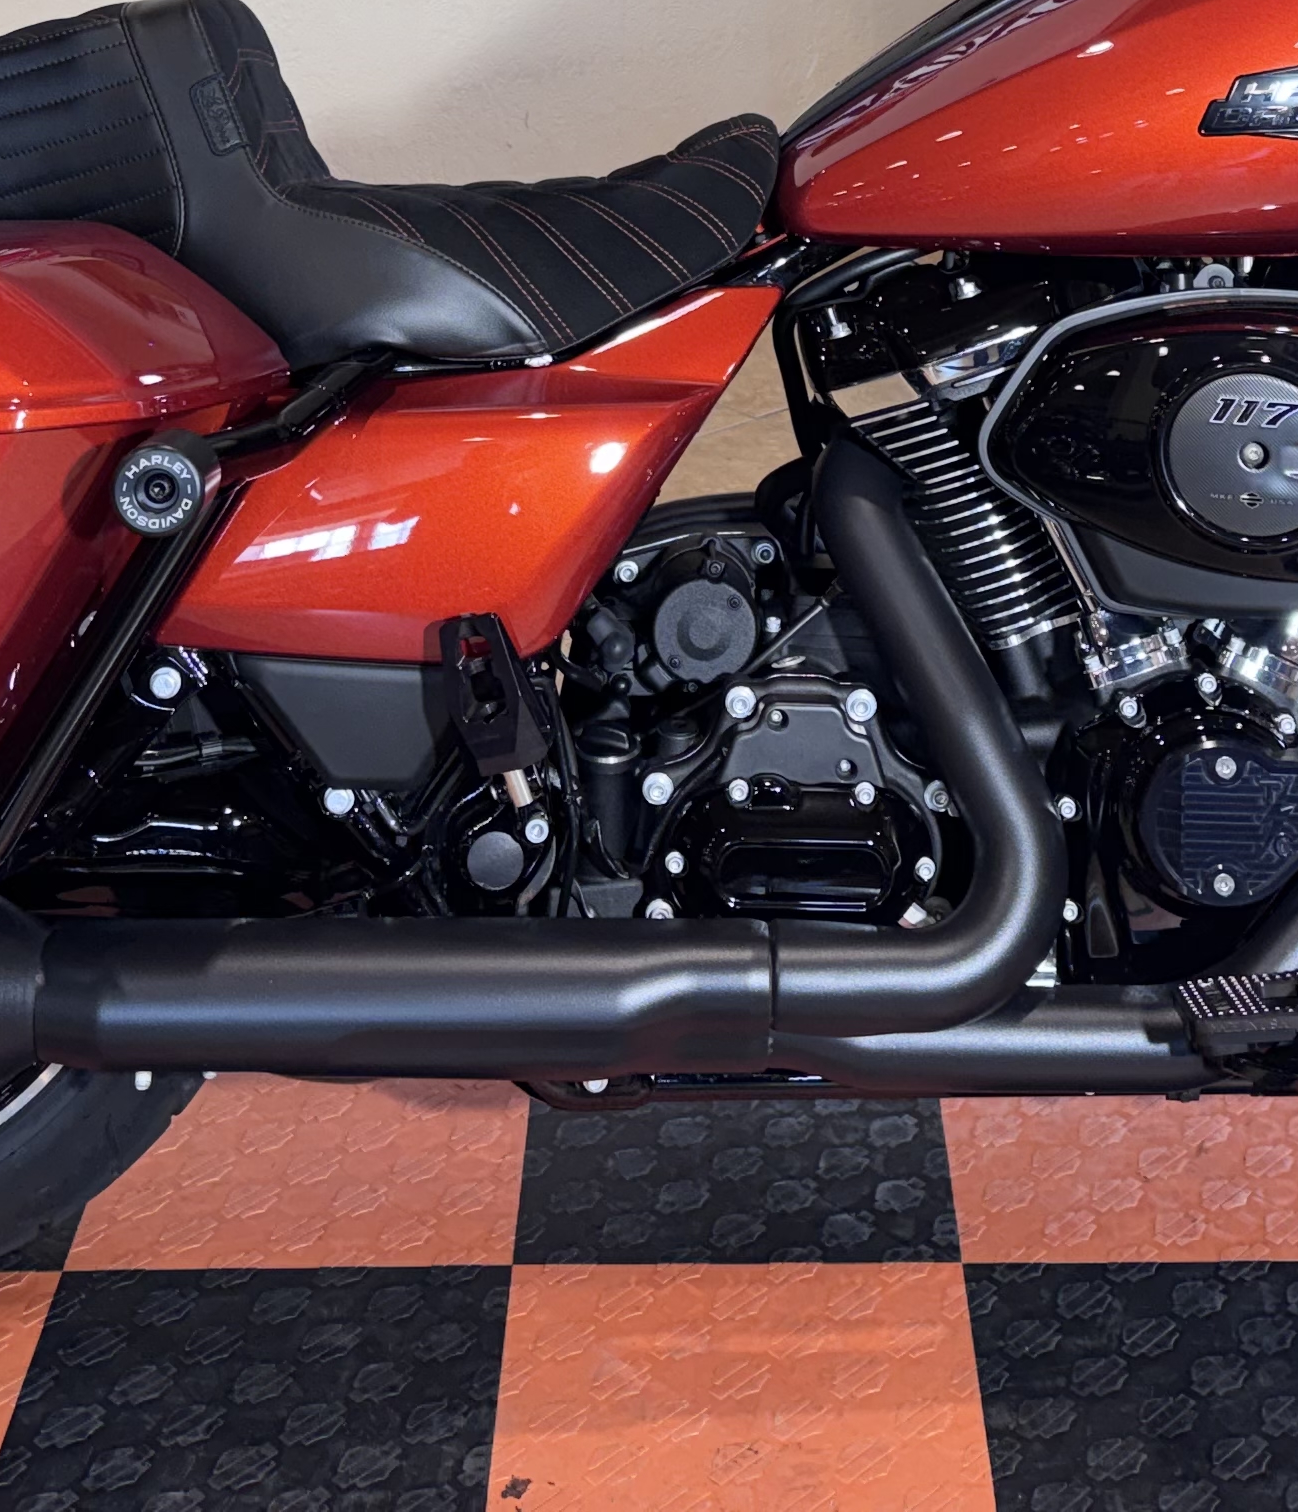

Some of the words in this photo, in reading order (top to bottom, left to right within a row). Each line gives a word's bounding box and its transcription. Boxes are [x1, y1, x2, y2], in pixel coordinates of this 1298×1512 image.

[124, 454, 192, 480] HARLEY
[119, 495, 193, 529] DAVIDSON
[1270, 498, 1294, 507] USA
